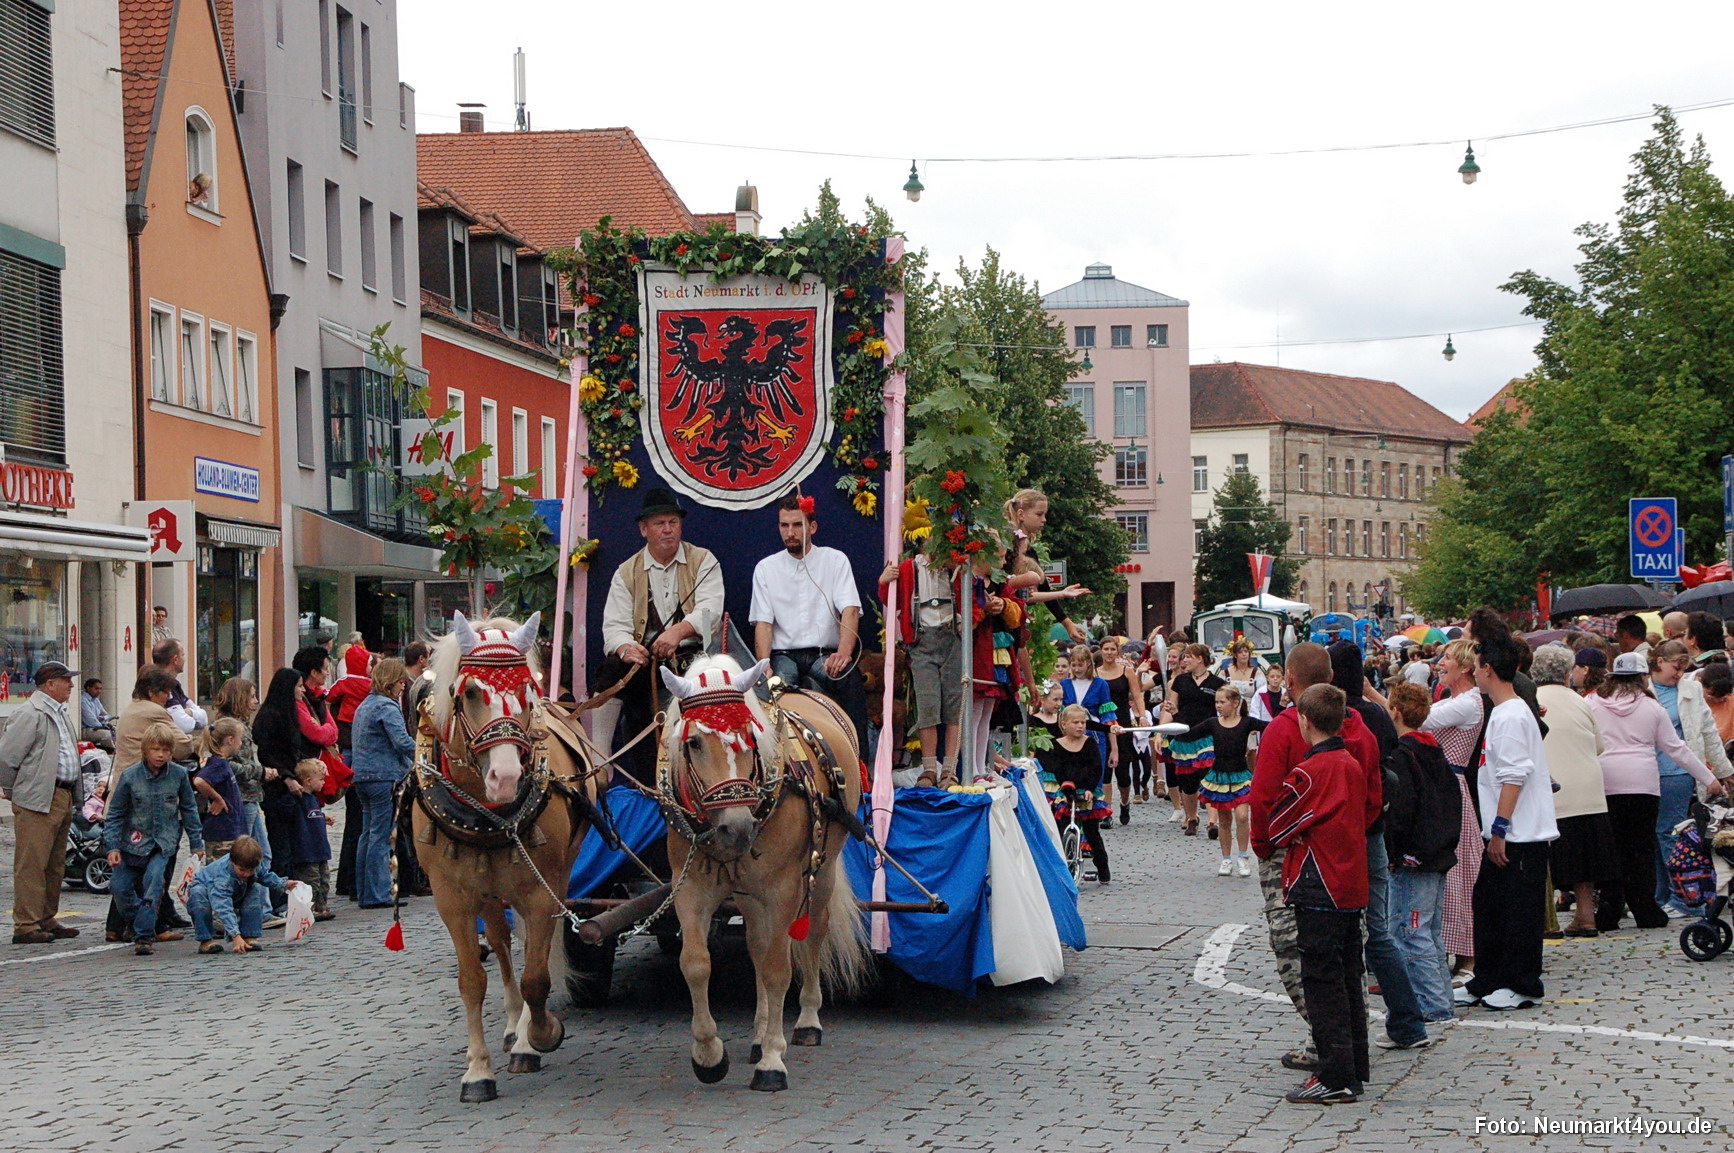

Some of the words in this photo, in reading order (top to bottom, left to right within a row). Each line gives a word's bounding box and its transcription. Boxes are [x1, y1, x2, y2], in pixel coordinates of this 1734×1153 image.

[654, 285, 689, 298] Stadt
[693, 284, 760, 298] Neumarkt
[764, 283, 772, 296] i.
[775, 283, 788, 296] d.
[1635, 553, 1672, 570] TAXI
